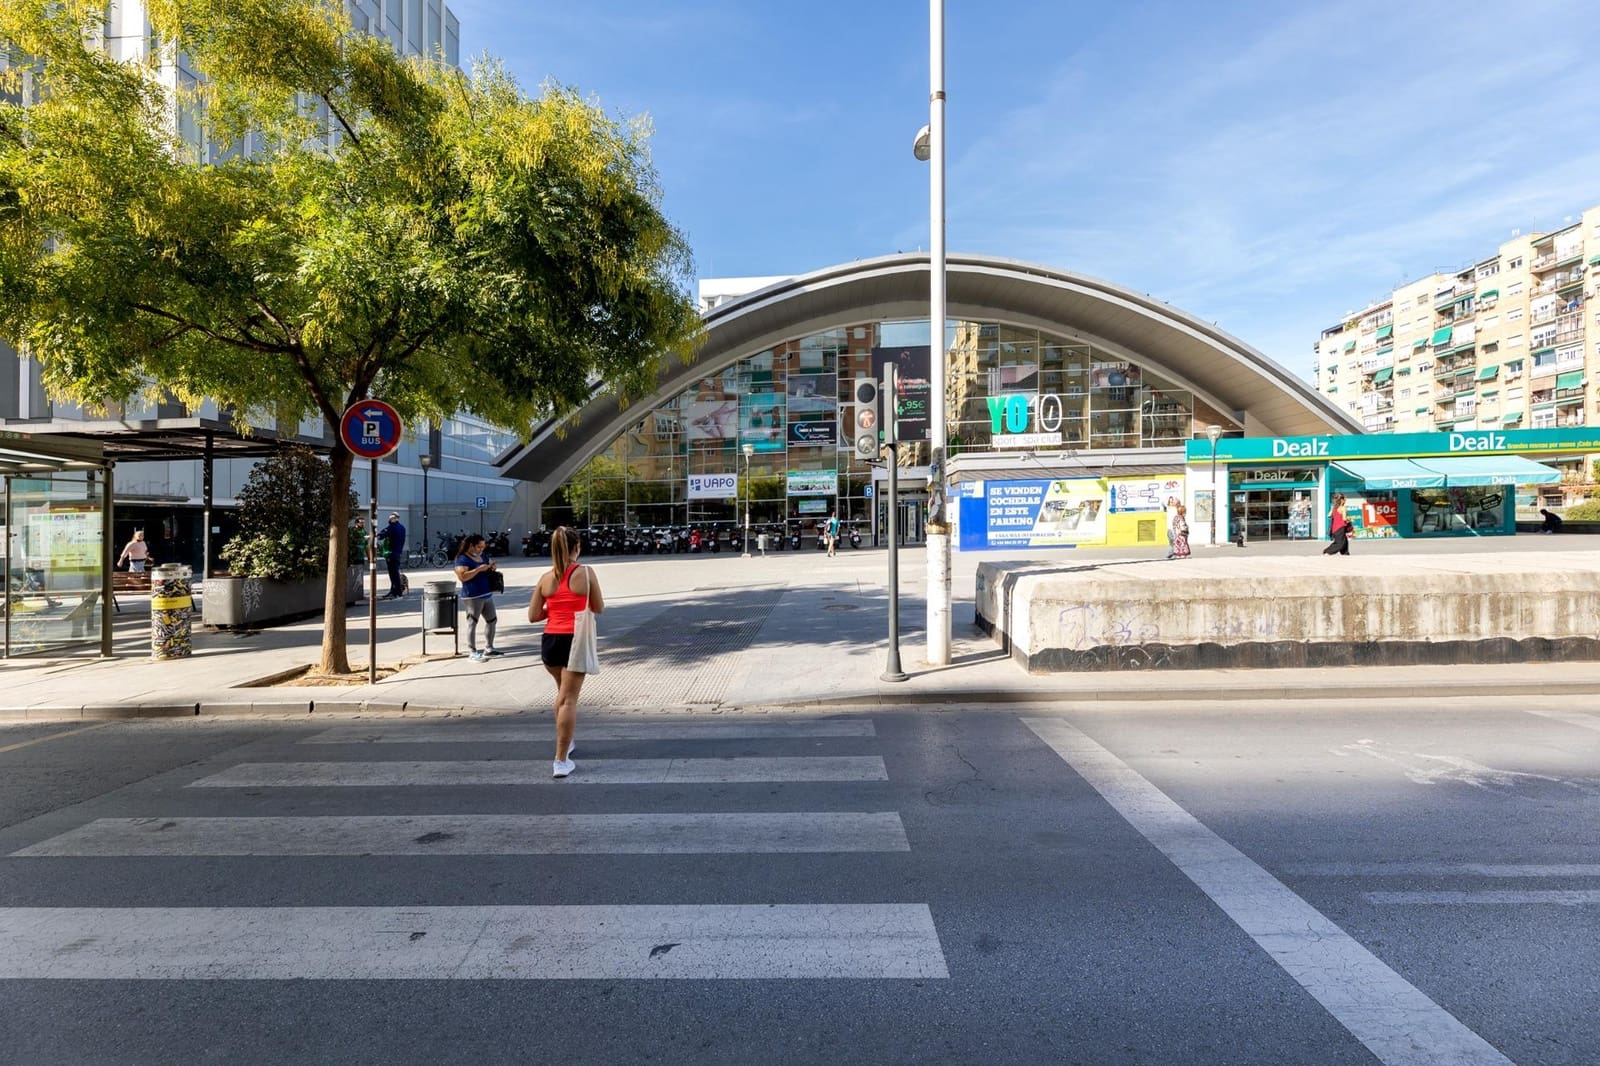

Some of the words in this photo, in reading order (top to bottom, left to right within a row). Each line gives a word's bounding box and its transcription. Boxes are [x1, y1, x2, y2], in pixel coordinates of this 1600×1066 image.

[985, 394, 1063, 434] YO10
[366, 423, 376, 435] P
[361, 437, 381, 445] BUS
[1449, 432, 1506, 451] Dealz
[1272, 438, 1329, 457] Dealz
[1254, 470, 1289, 481] Dealz
[1491, 475, 1516, 485] Dealz
[703, 477, 735, 488] UAPO
[1392, 479, 1418, 488] Dealz
[990, 487, 1002, 495] SE
[1004, 486, 1043, 495] VENDEN
[990, 497, 1041, 506] COCHERAS
[990, 507, 1003, 516] EN
[1005, 507, 1029, 515] ESTE
[990, 517, 1034, 526] PARKING
